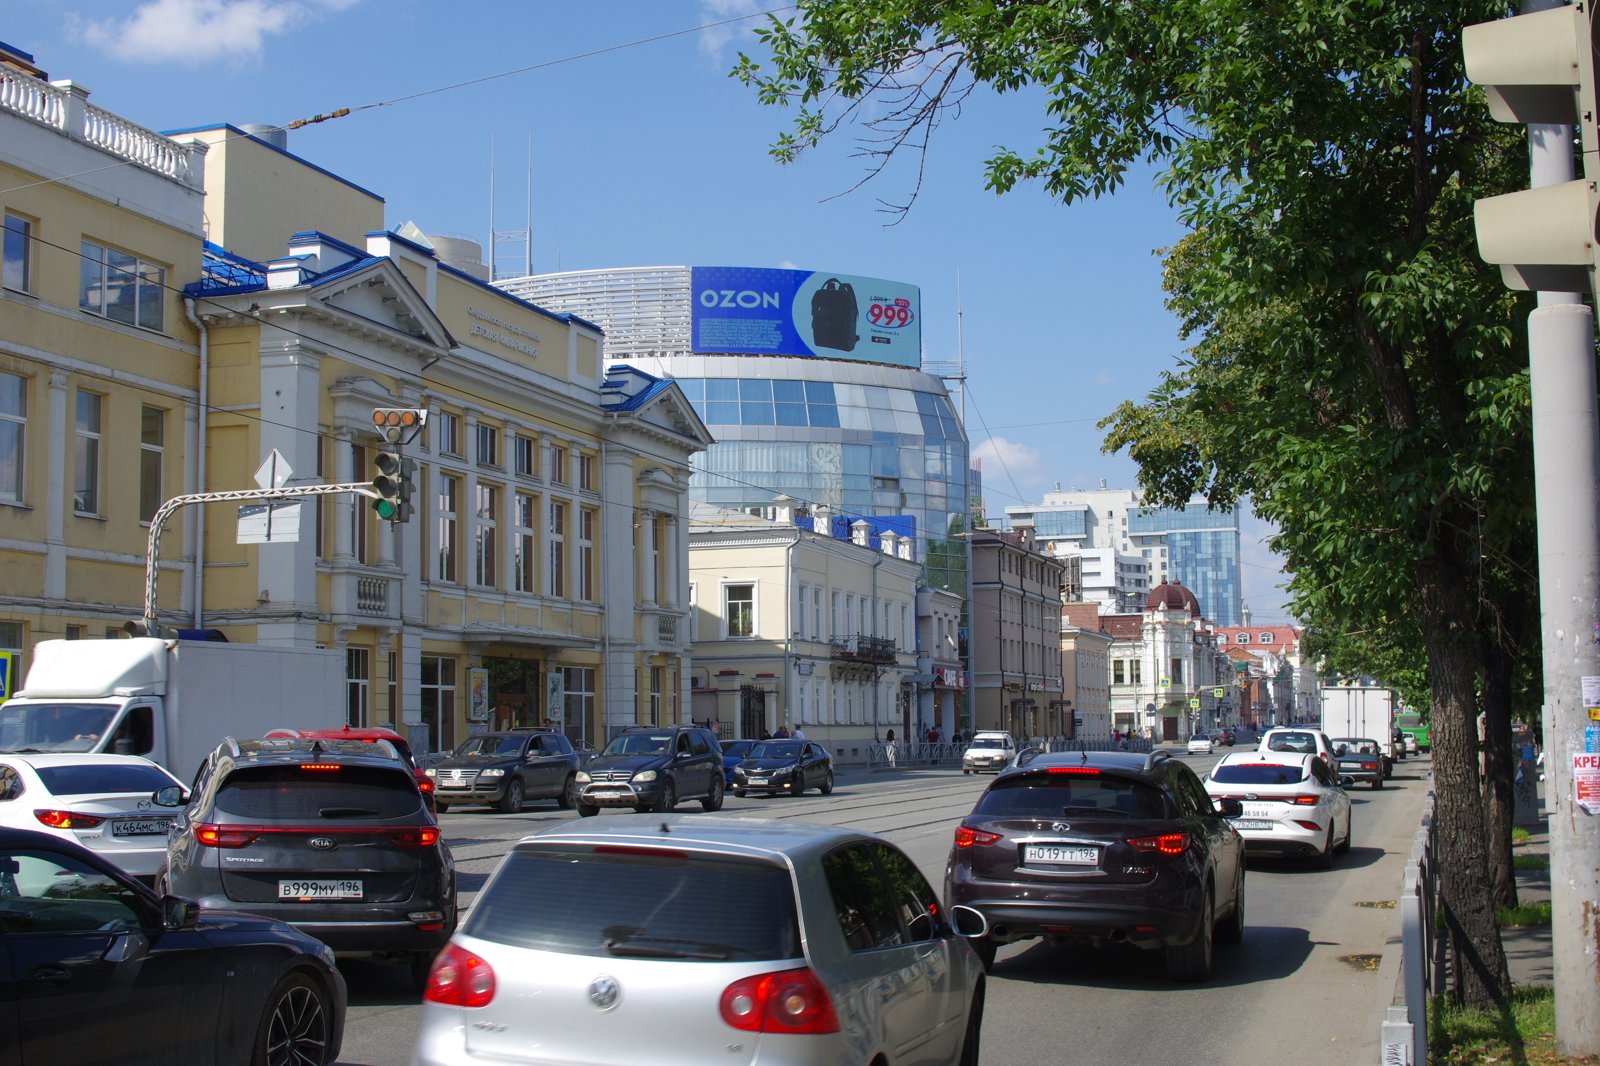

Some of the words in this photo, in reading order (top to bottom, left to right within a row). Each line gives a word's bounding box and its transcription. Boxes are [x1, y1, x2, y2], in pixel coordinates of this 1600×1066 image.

[700, 290, 779, 309] OZON
[870, 304, 908, 328] 999
[1574, 756, 1600, 769] КРЕ
[116, 822, 154, 832] К464МС
[156, 821, 170, 829] 196
[1029, 847, 1074, 860] Н019ТТ
[1078, 848, 1095, 858] 196
[283, 882, 336, 896] В999МУ
[339, 881, 359, 892] 196
